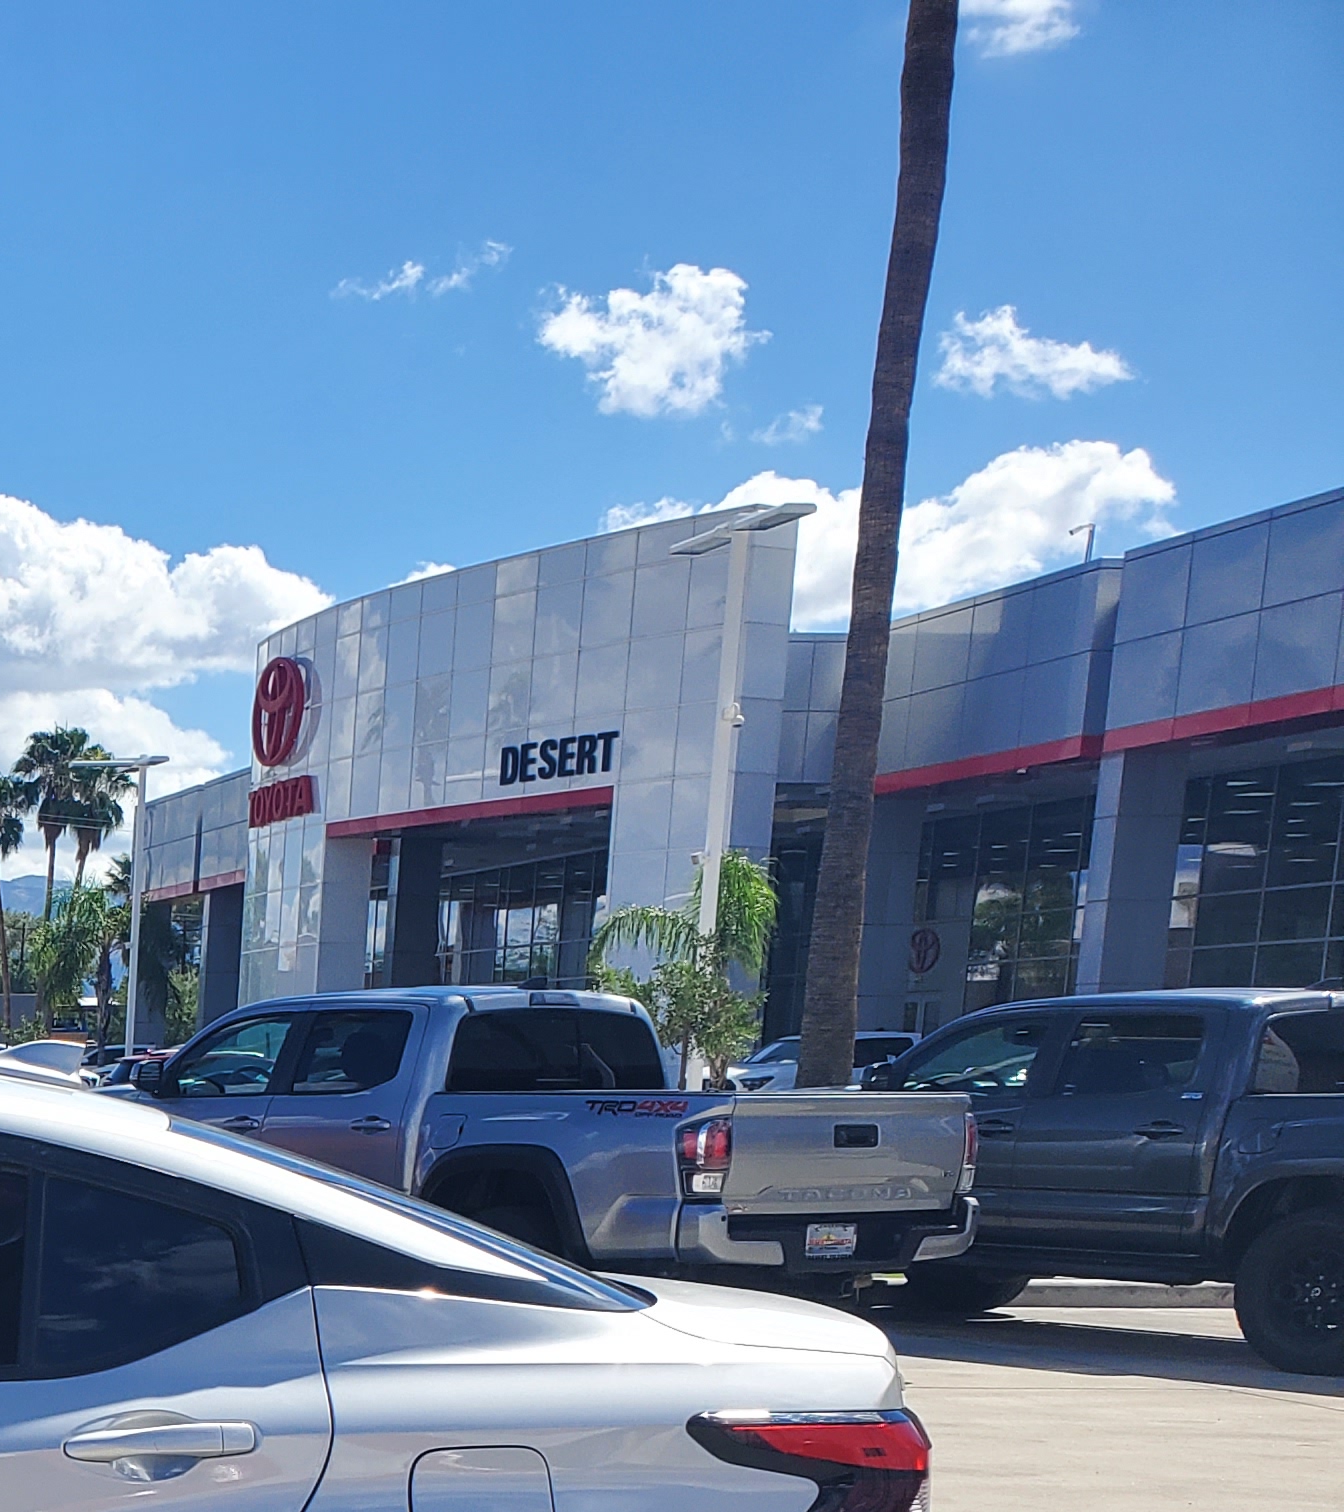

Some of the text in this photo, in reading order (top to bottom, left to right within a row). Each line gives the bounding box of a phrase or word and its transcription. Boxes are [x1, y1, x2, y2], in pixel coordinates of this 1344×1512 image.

[500, 731, 621, 786] DESERT
[249, 775, 311, 828] TOYOTA
[585, 1100, 637, 1117] TRD
[778, 1186, 912, 1202] TACOMA
